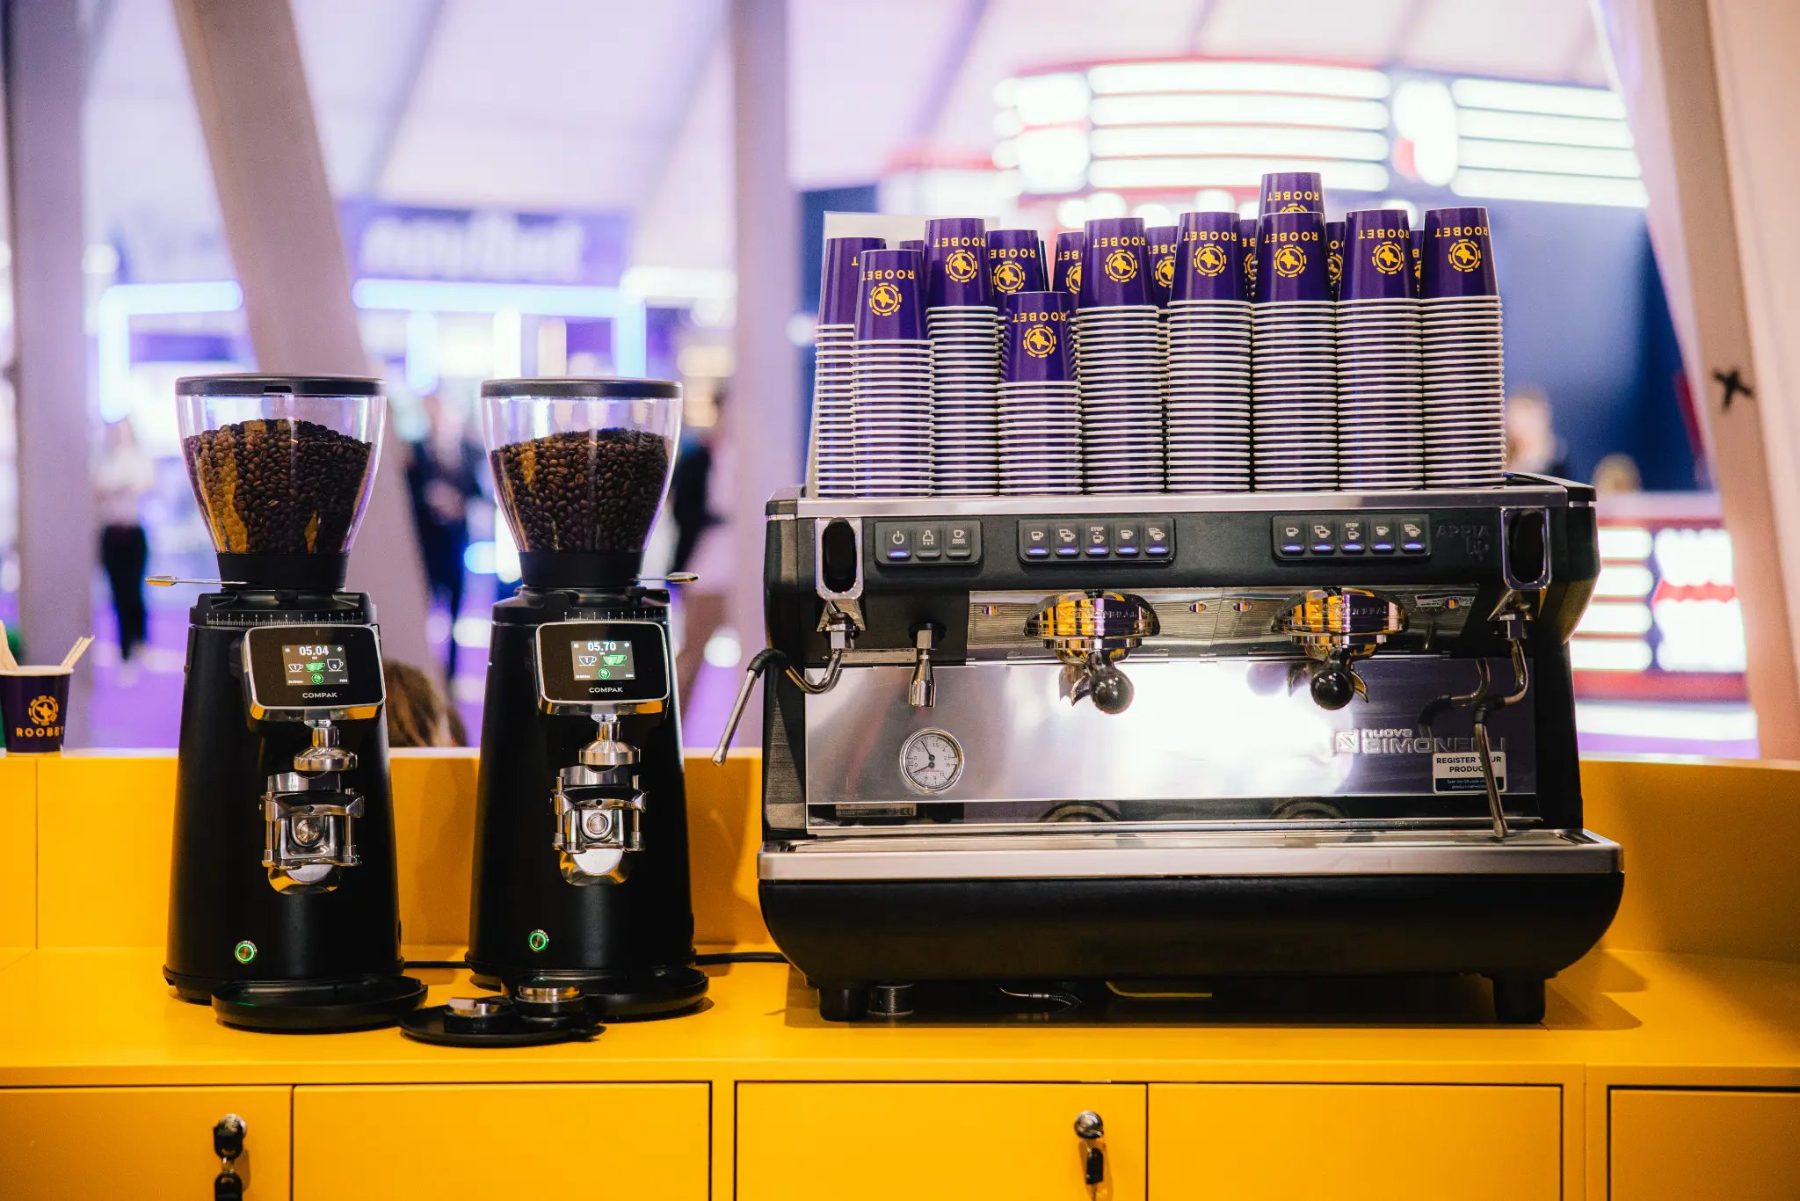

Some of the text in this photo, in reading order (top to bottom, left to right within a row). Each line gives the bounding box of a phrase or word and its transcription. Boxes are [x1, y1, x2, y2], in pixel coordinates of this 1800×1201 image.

[1266, 191, 1319, 202] ROOBET
[1183, 231, 1236, 242] ROOBET
[1358, 229, 1410, 240] ROOBET
[1434, 226, 1488, 238] ROOBET
[933, 237, 985, 248] ROOBET
[1092, 237, 1146, 248] ROOBET
[1263, 232, 1317, 244] ROOBET
[989, 248, 1035, 259] ROOBE
[1147, 244, 1176, 255] OBET
[1013, 312, 1066, 323] ROOBET
[299, 645, 329, 656] 05.04
[588, 641, 616, 651] 05.70
[1361, 728, 1413, 738] nuova
[1436, 756, 1476, 764] REGISTER
